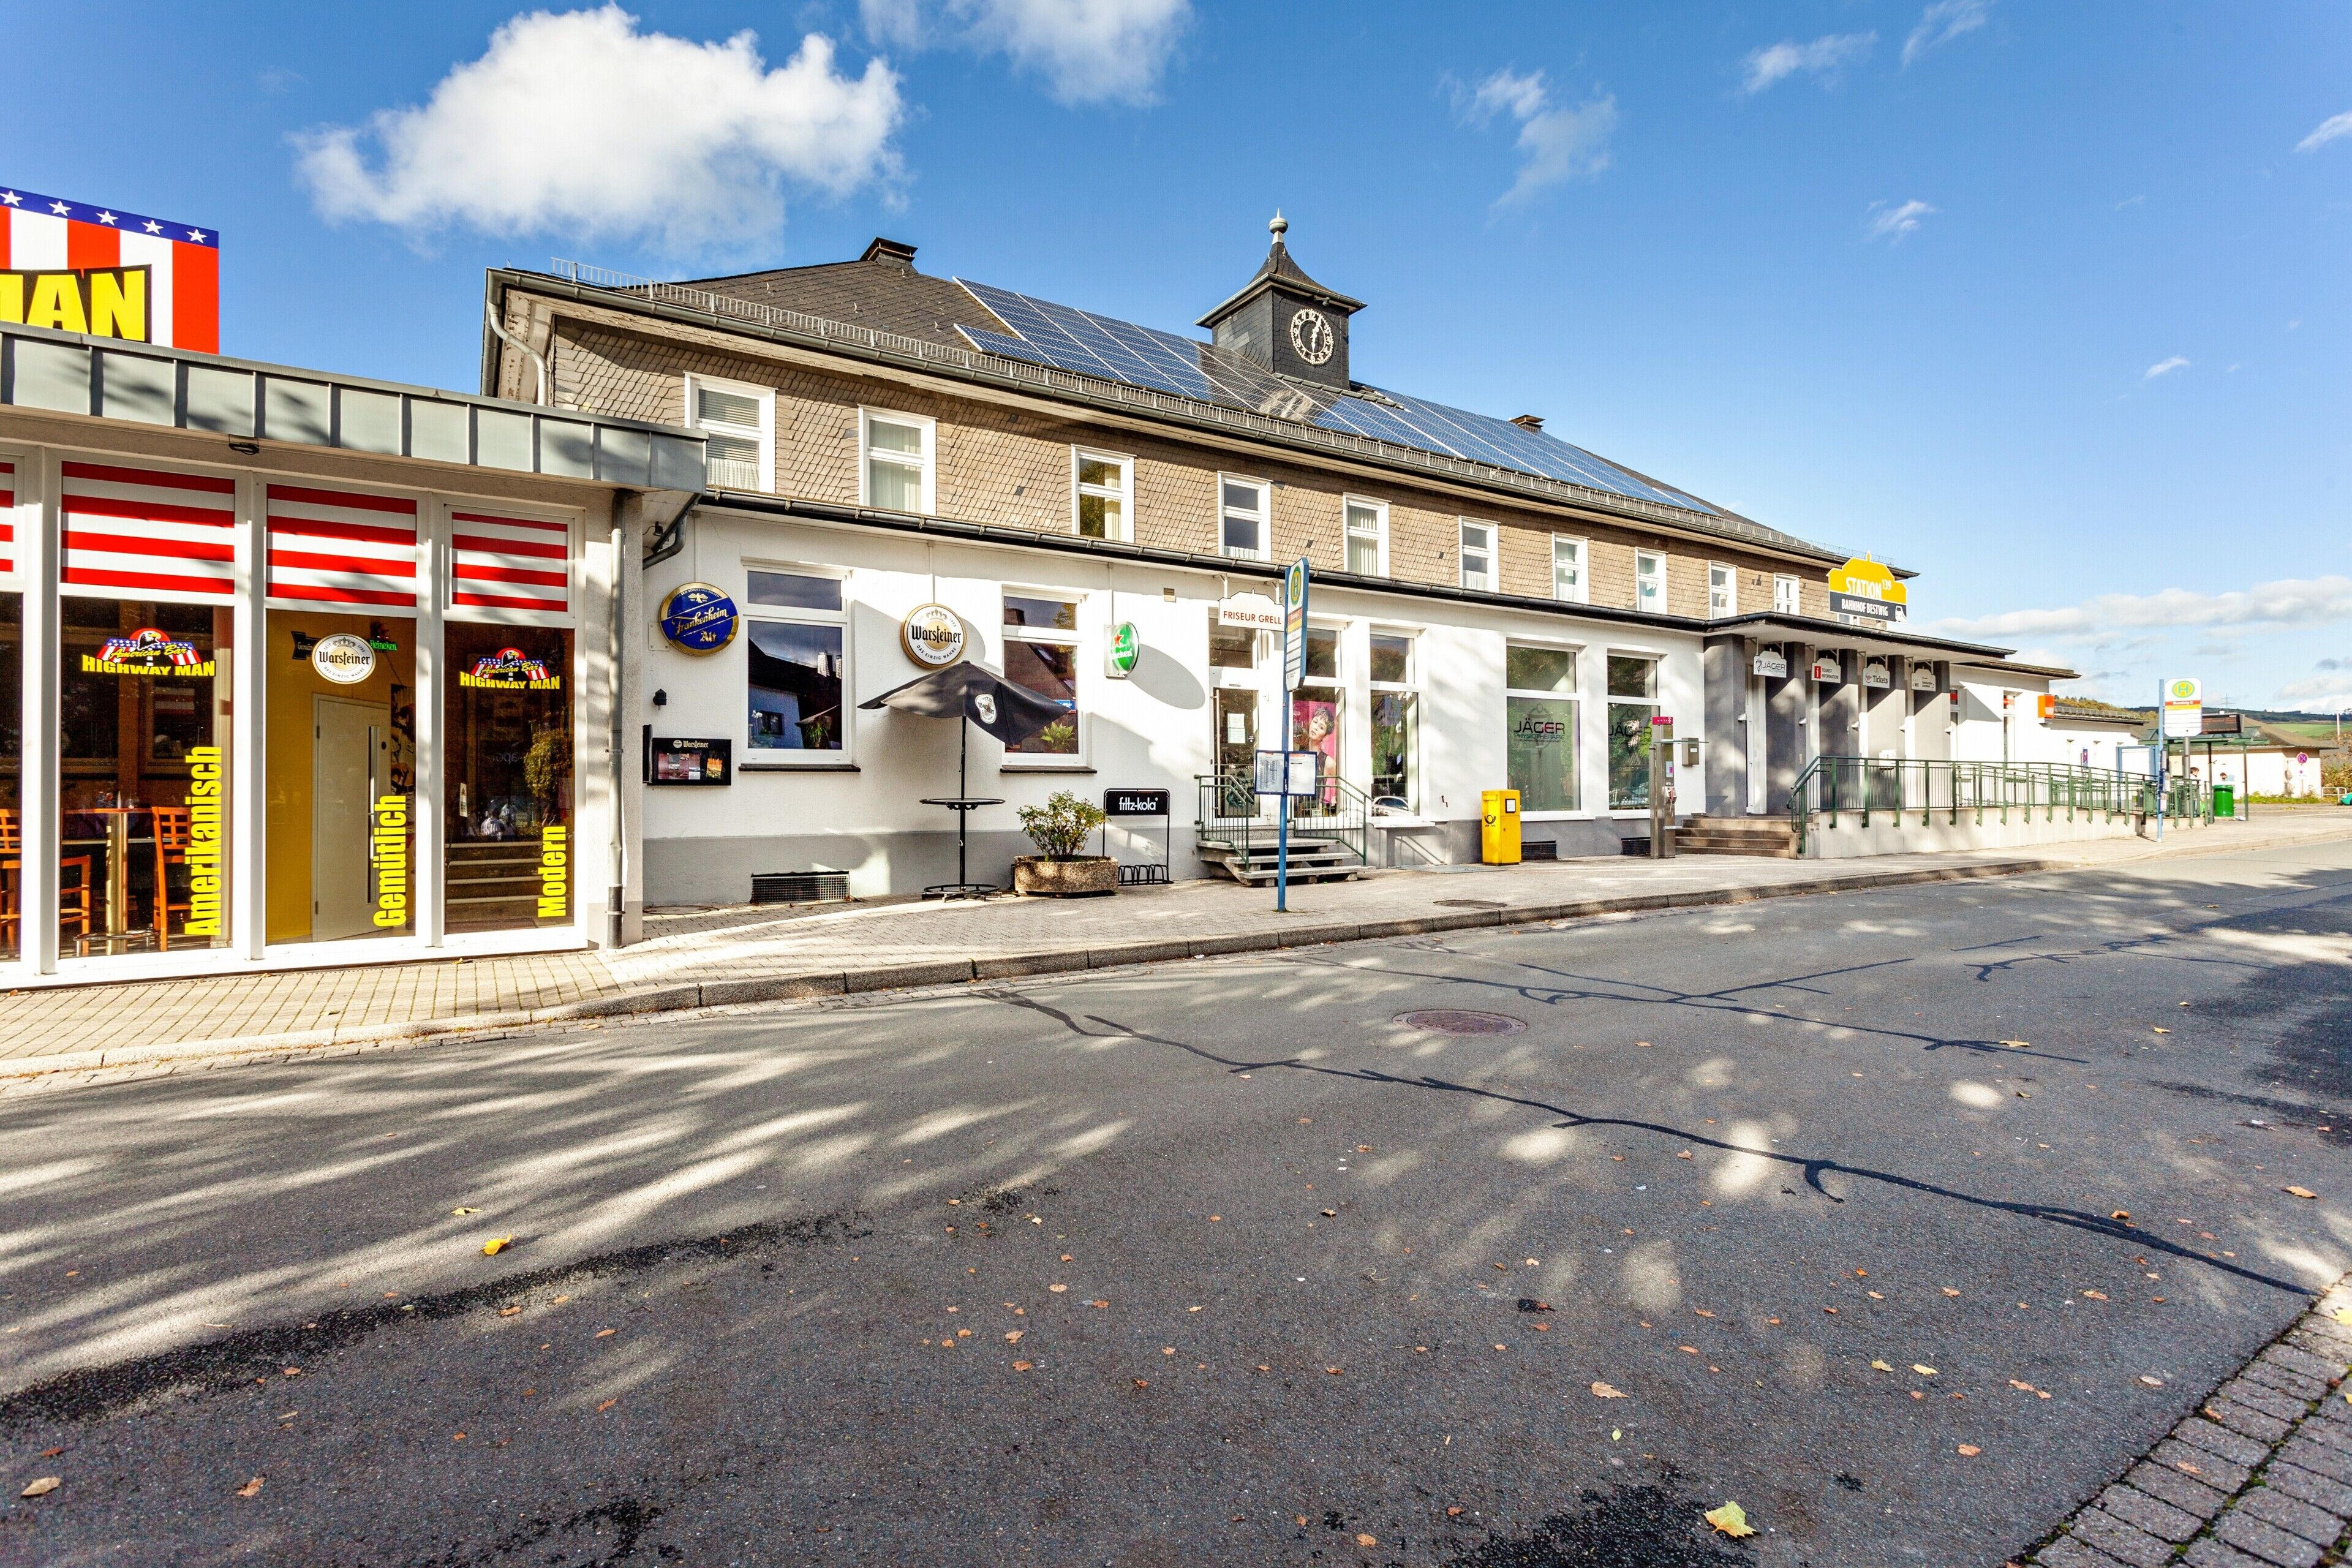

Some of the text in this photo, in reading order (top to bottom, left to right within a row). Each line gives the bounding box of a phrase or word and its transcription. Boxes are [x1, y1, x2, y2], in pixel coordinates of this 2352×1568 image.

[1845, 576, 1891, 600] STATION 139
[1841, 598, 1889, 617] BAHNHOF BESTWIG
[671, 606, 729, 636] Frankenheim
[1223, 611, 1256, 622] FRISEUR
[1258, 614, 1282, 625] GRELL
[700, 630, 717, 642] Alt
[911, 625, 962, 644] Warsteiner
[109, 644, 187, 659] American Bar
[370, 639, 398, 650] Heineken
[82, 654, 216, 676] HIGHWAY MAN
[319, 651, 371, 665] Warsteiner
[1762, 661, 1785, 670] JÄGER
[480, 661, 539, 675] American Bar
[460, 671, 560, 689] HIGHWAY MAN
[1872, 675, 1888, 684] Tickets
[1513, 717, 1565, 734] JÄGER
[683, 740, 709, 748] Warsteiner
[1118, 796, 1156, 811] fritz-kola
[184, 746, 222, 936] Amerikanisch
[372, 795, 407, 927] Gemütlich
[537, 826, 567, 918] Modern
